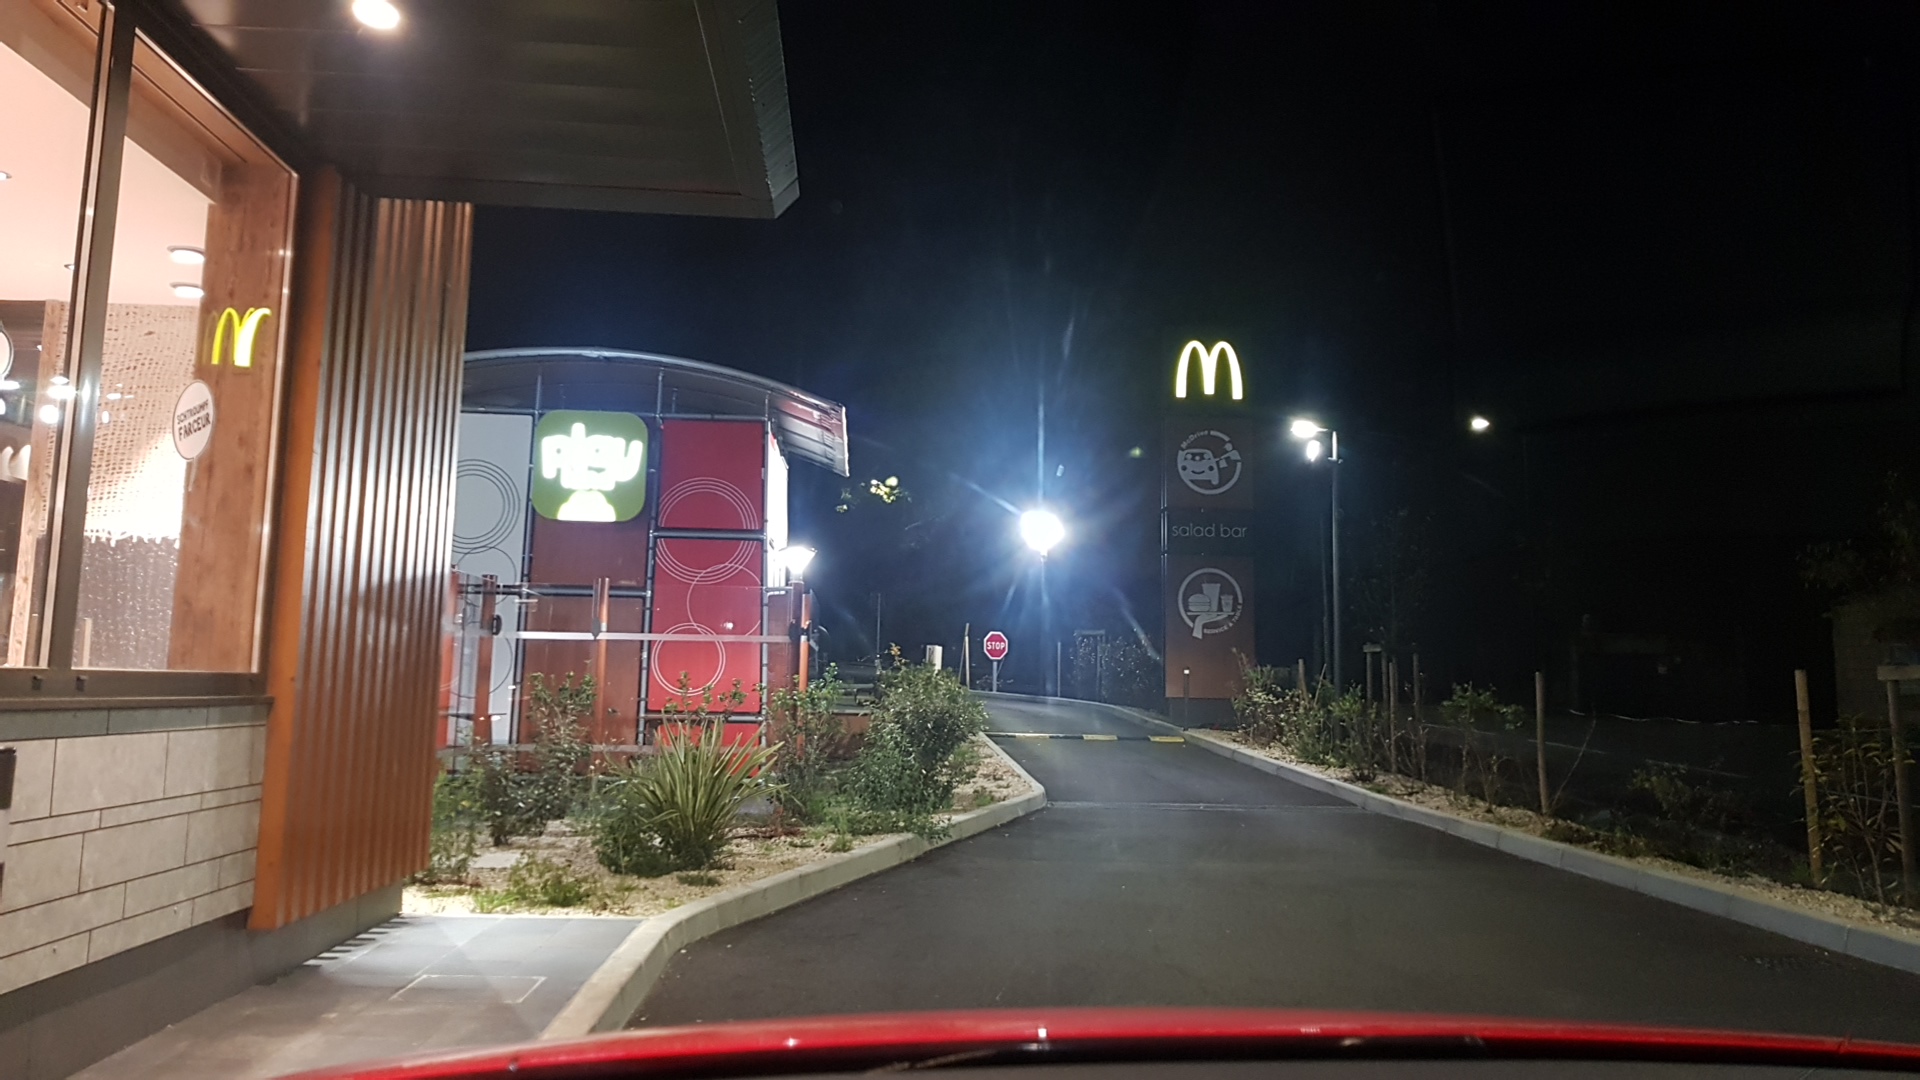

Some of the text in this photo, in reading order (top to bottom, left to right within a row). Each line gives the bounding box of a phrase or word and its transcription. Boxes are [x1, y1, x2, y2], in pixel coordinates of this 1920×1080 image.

[178, 412, 211, 441] FARCEUR
[1172, 523, 1248, 538] salad bar
[987, 641, 1005, 650] STOP
